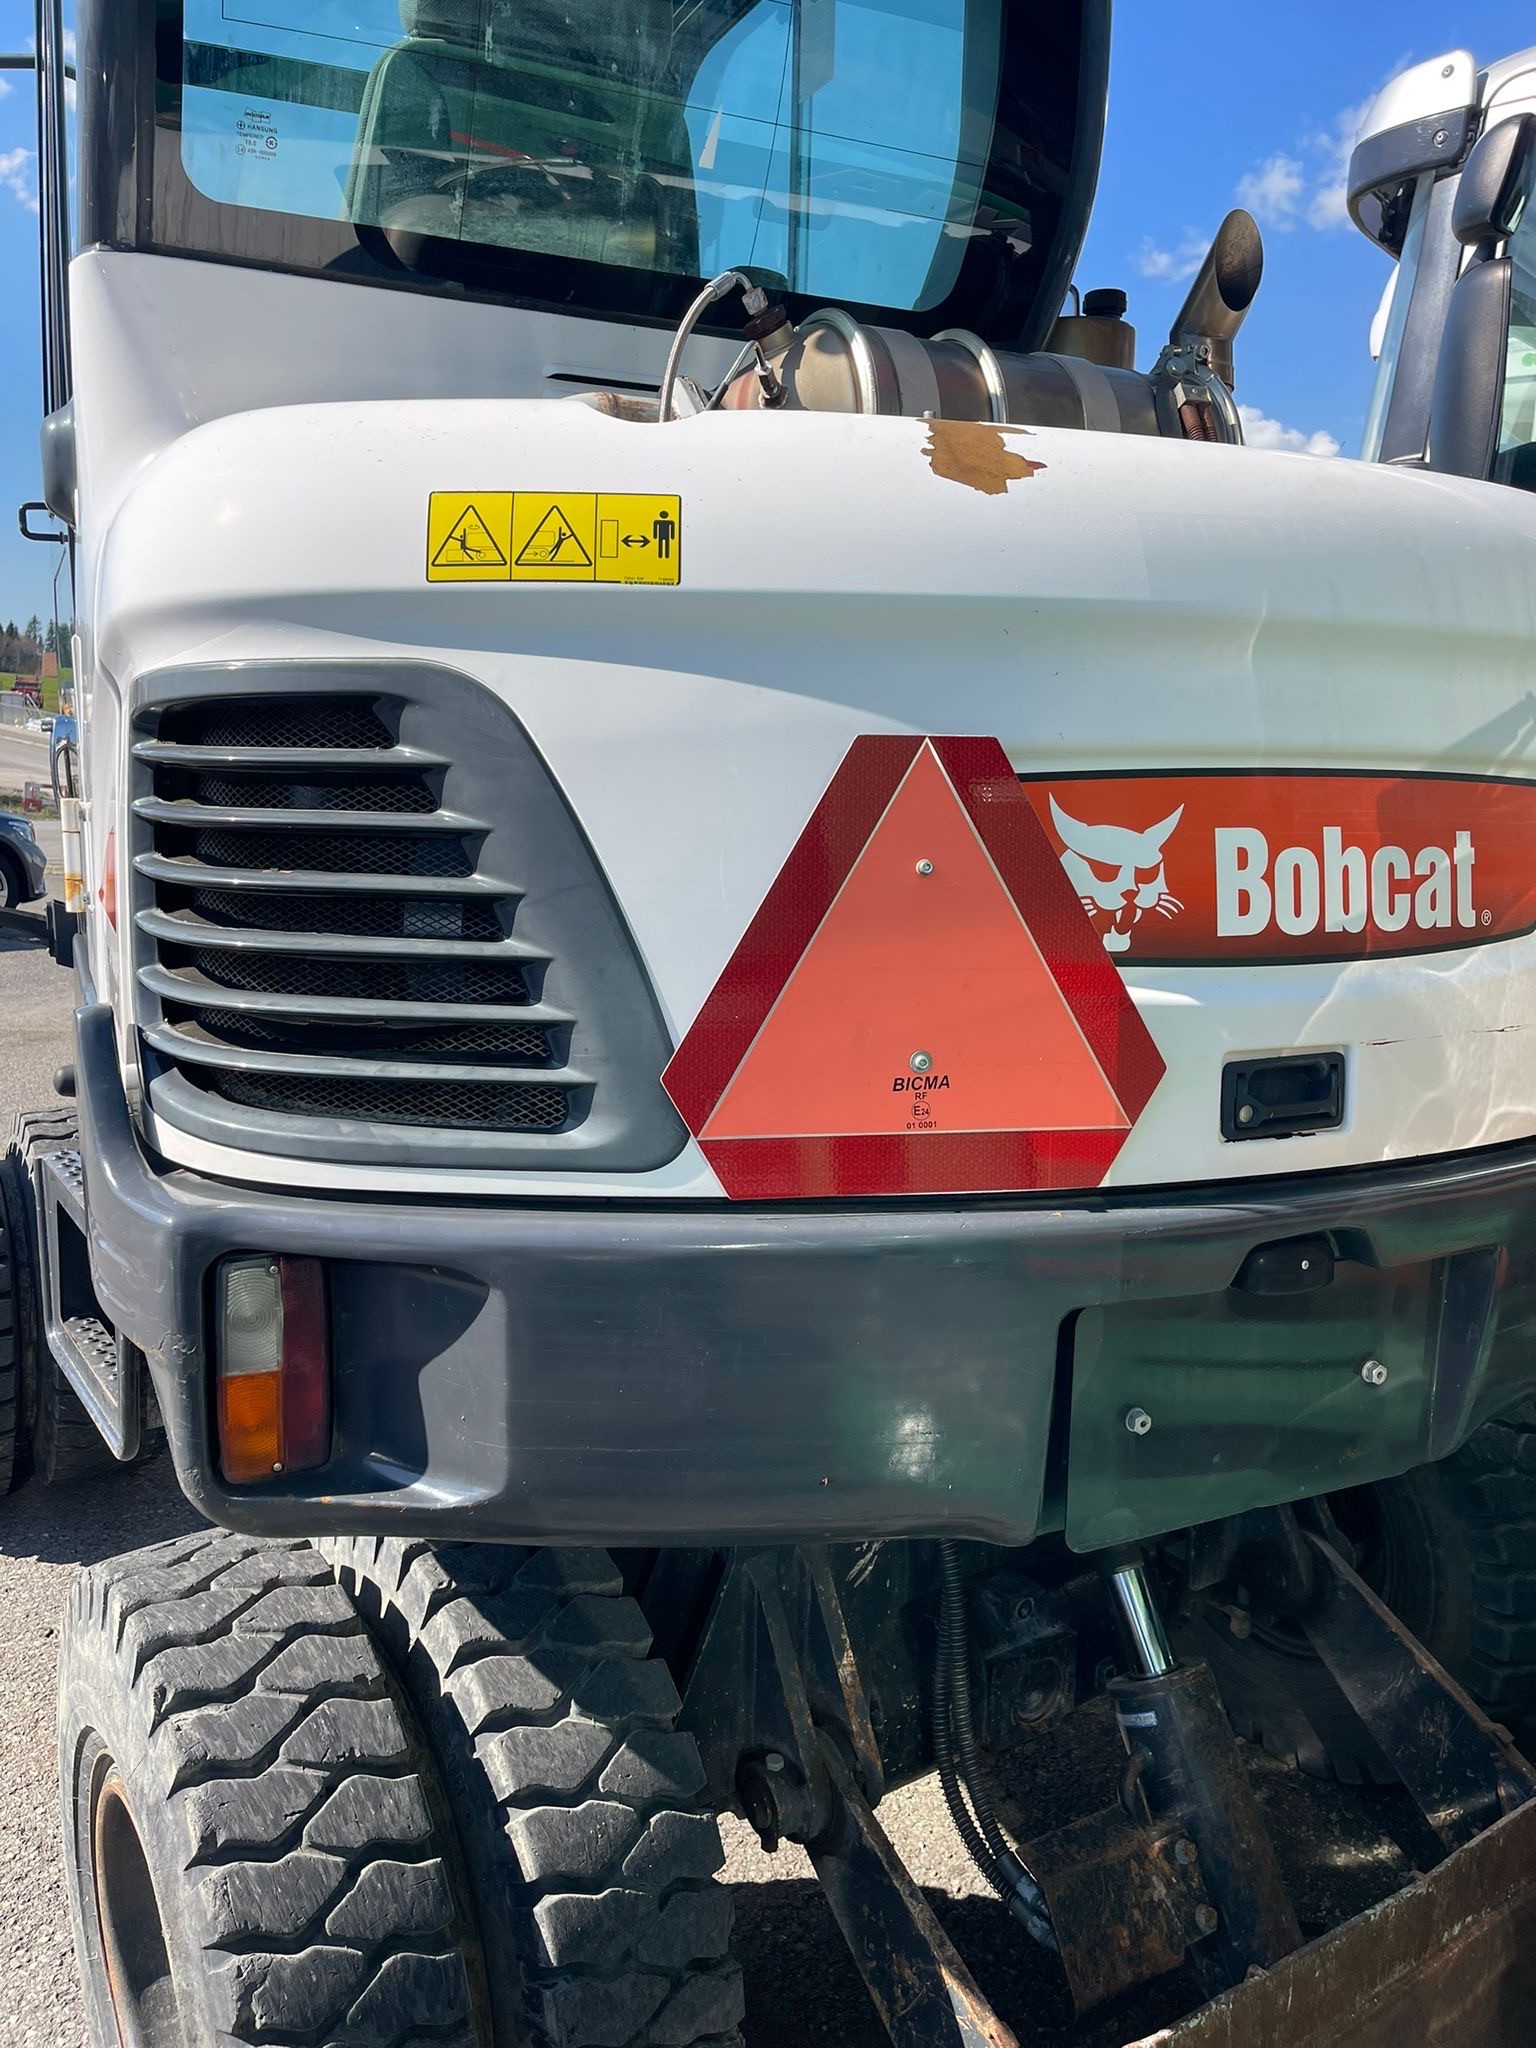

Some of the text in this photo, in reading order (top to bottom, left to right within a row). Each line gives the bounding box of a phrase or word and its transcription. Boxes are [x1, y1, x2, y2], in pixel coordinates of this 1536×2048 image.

[247, 124, 278, 134] HANSUNG
[1214, 826, 1476, 937] Bobcat
[892, 1075, 950, 1092] BICMA
[915, 1092, 927, 1100] RF
[913, 1105, 929, 1116] E24
[918, 1121, 937, 1129] 0001
